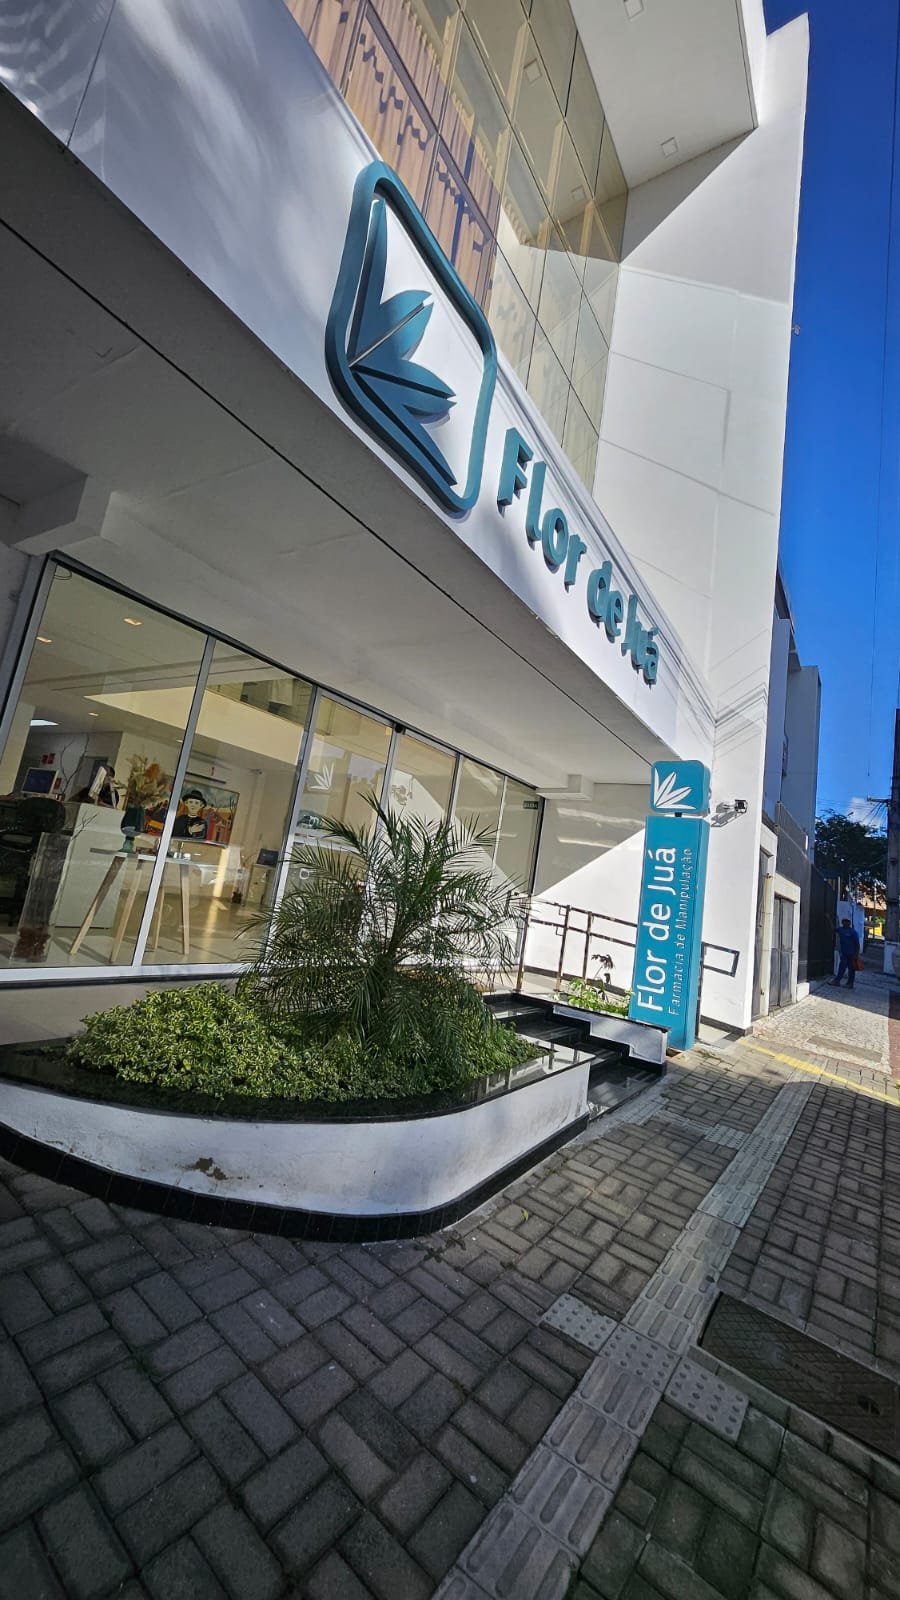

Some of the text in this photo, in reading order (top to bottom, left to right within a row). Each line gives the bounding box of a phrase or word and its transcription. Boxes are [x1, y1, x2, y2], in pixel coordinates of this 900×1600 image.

[497, 427, 587, 585] Flor
[587, 561, 623, 638] de
[636, 848, 676, 1011] Flor de Juá
[668, 848, 693, 1015] Farmácia de Manipulação
